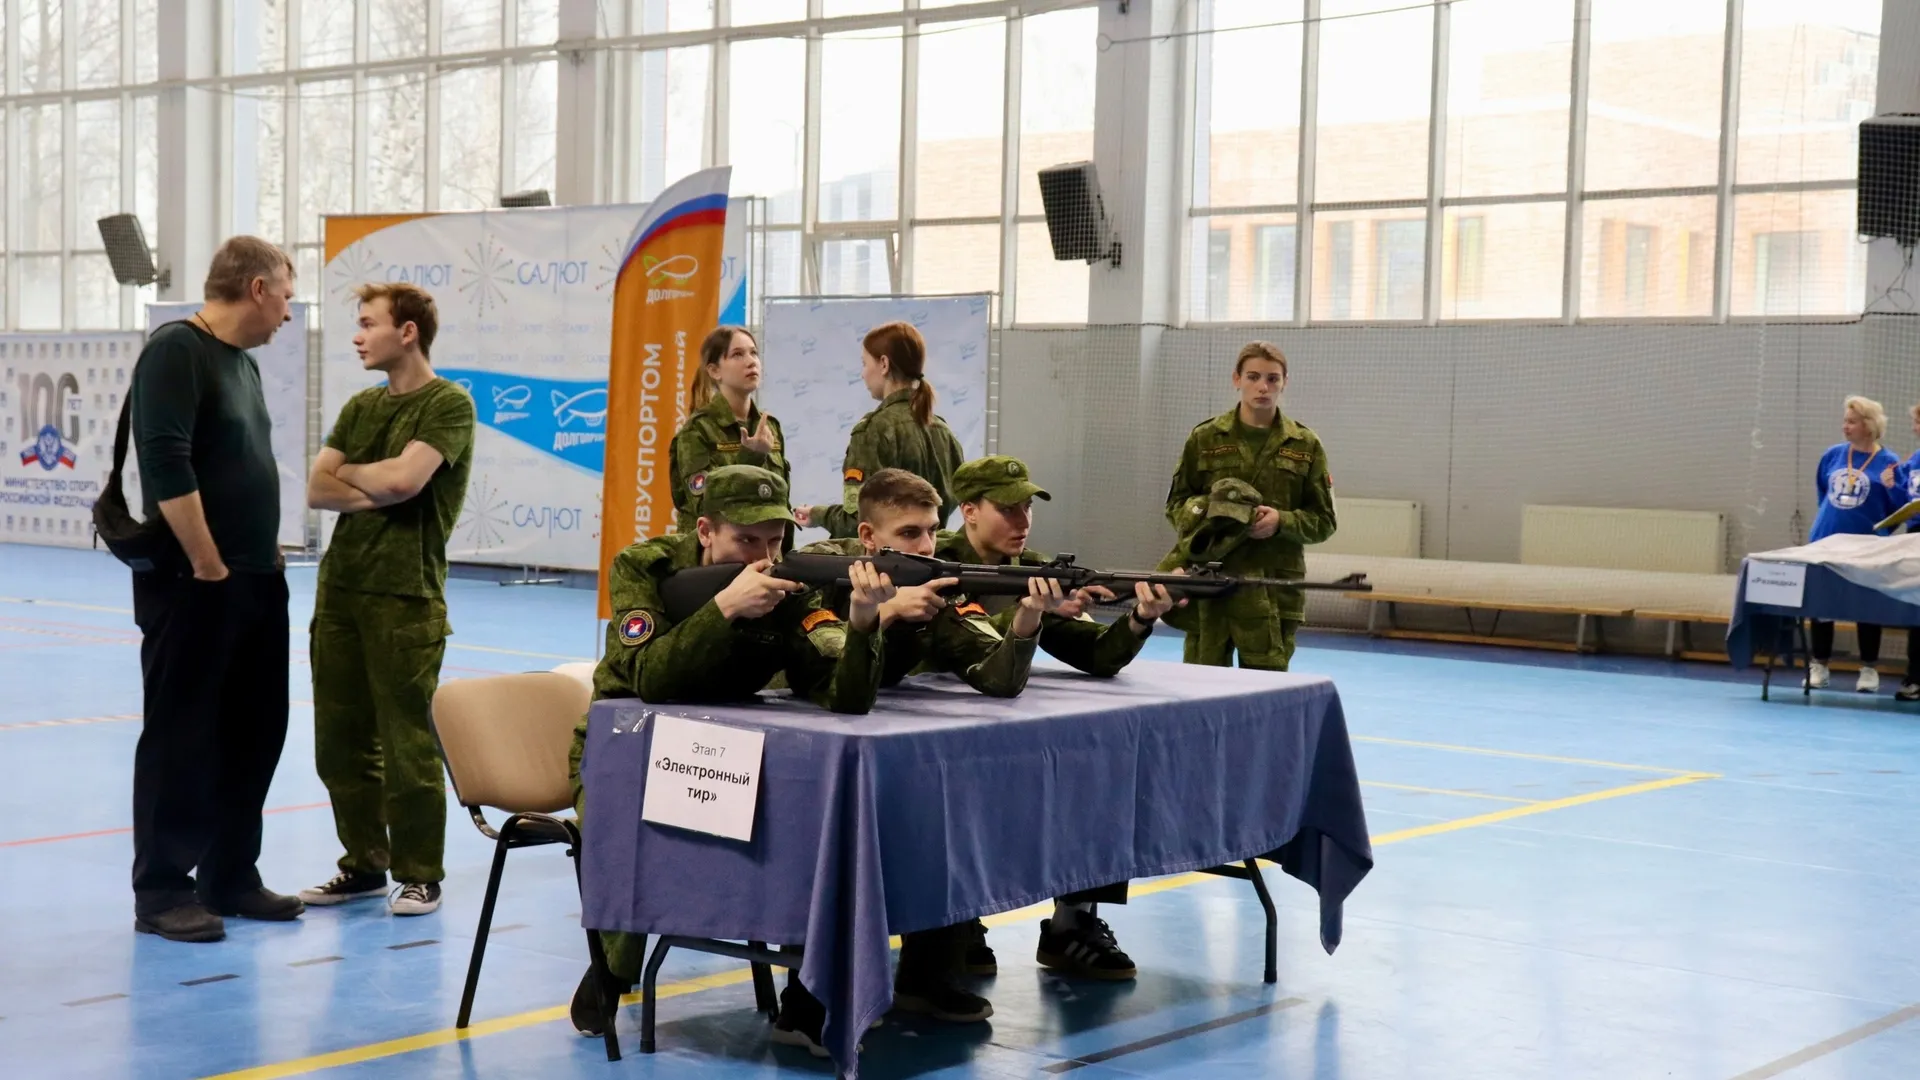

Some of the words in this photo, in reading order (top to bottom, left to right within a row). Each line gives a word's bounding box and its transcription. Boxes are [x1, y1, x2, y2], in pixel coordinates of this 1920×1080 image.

[386, 264, 453, 287] САЛЮТ
[517, 261, 588, 294] САЛЮТ
[54, 494, 98, 510] ФЕДЕРАЦИ
[512, 504, 582, 539] САЛЮТ
[691, 741, 717, 757] Этап
[719, 746, 726, 758] 7
[655, 757, 751, 786] «Электронный
[687, 786, 718, 804] тир»
